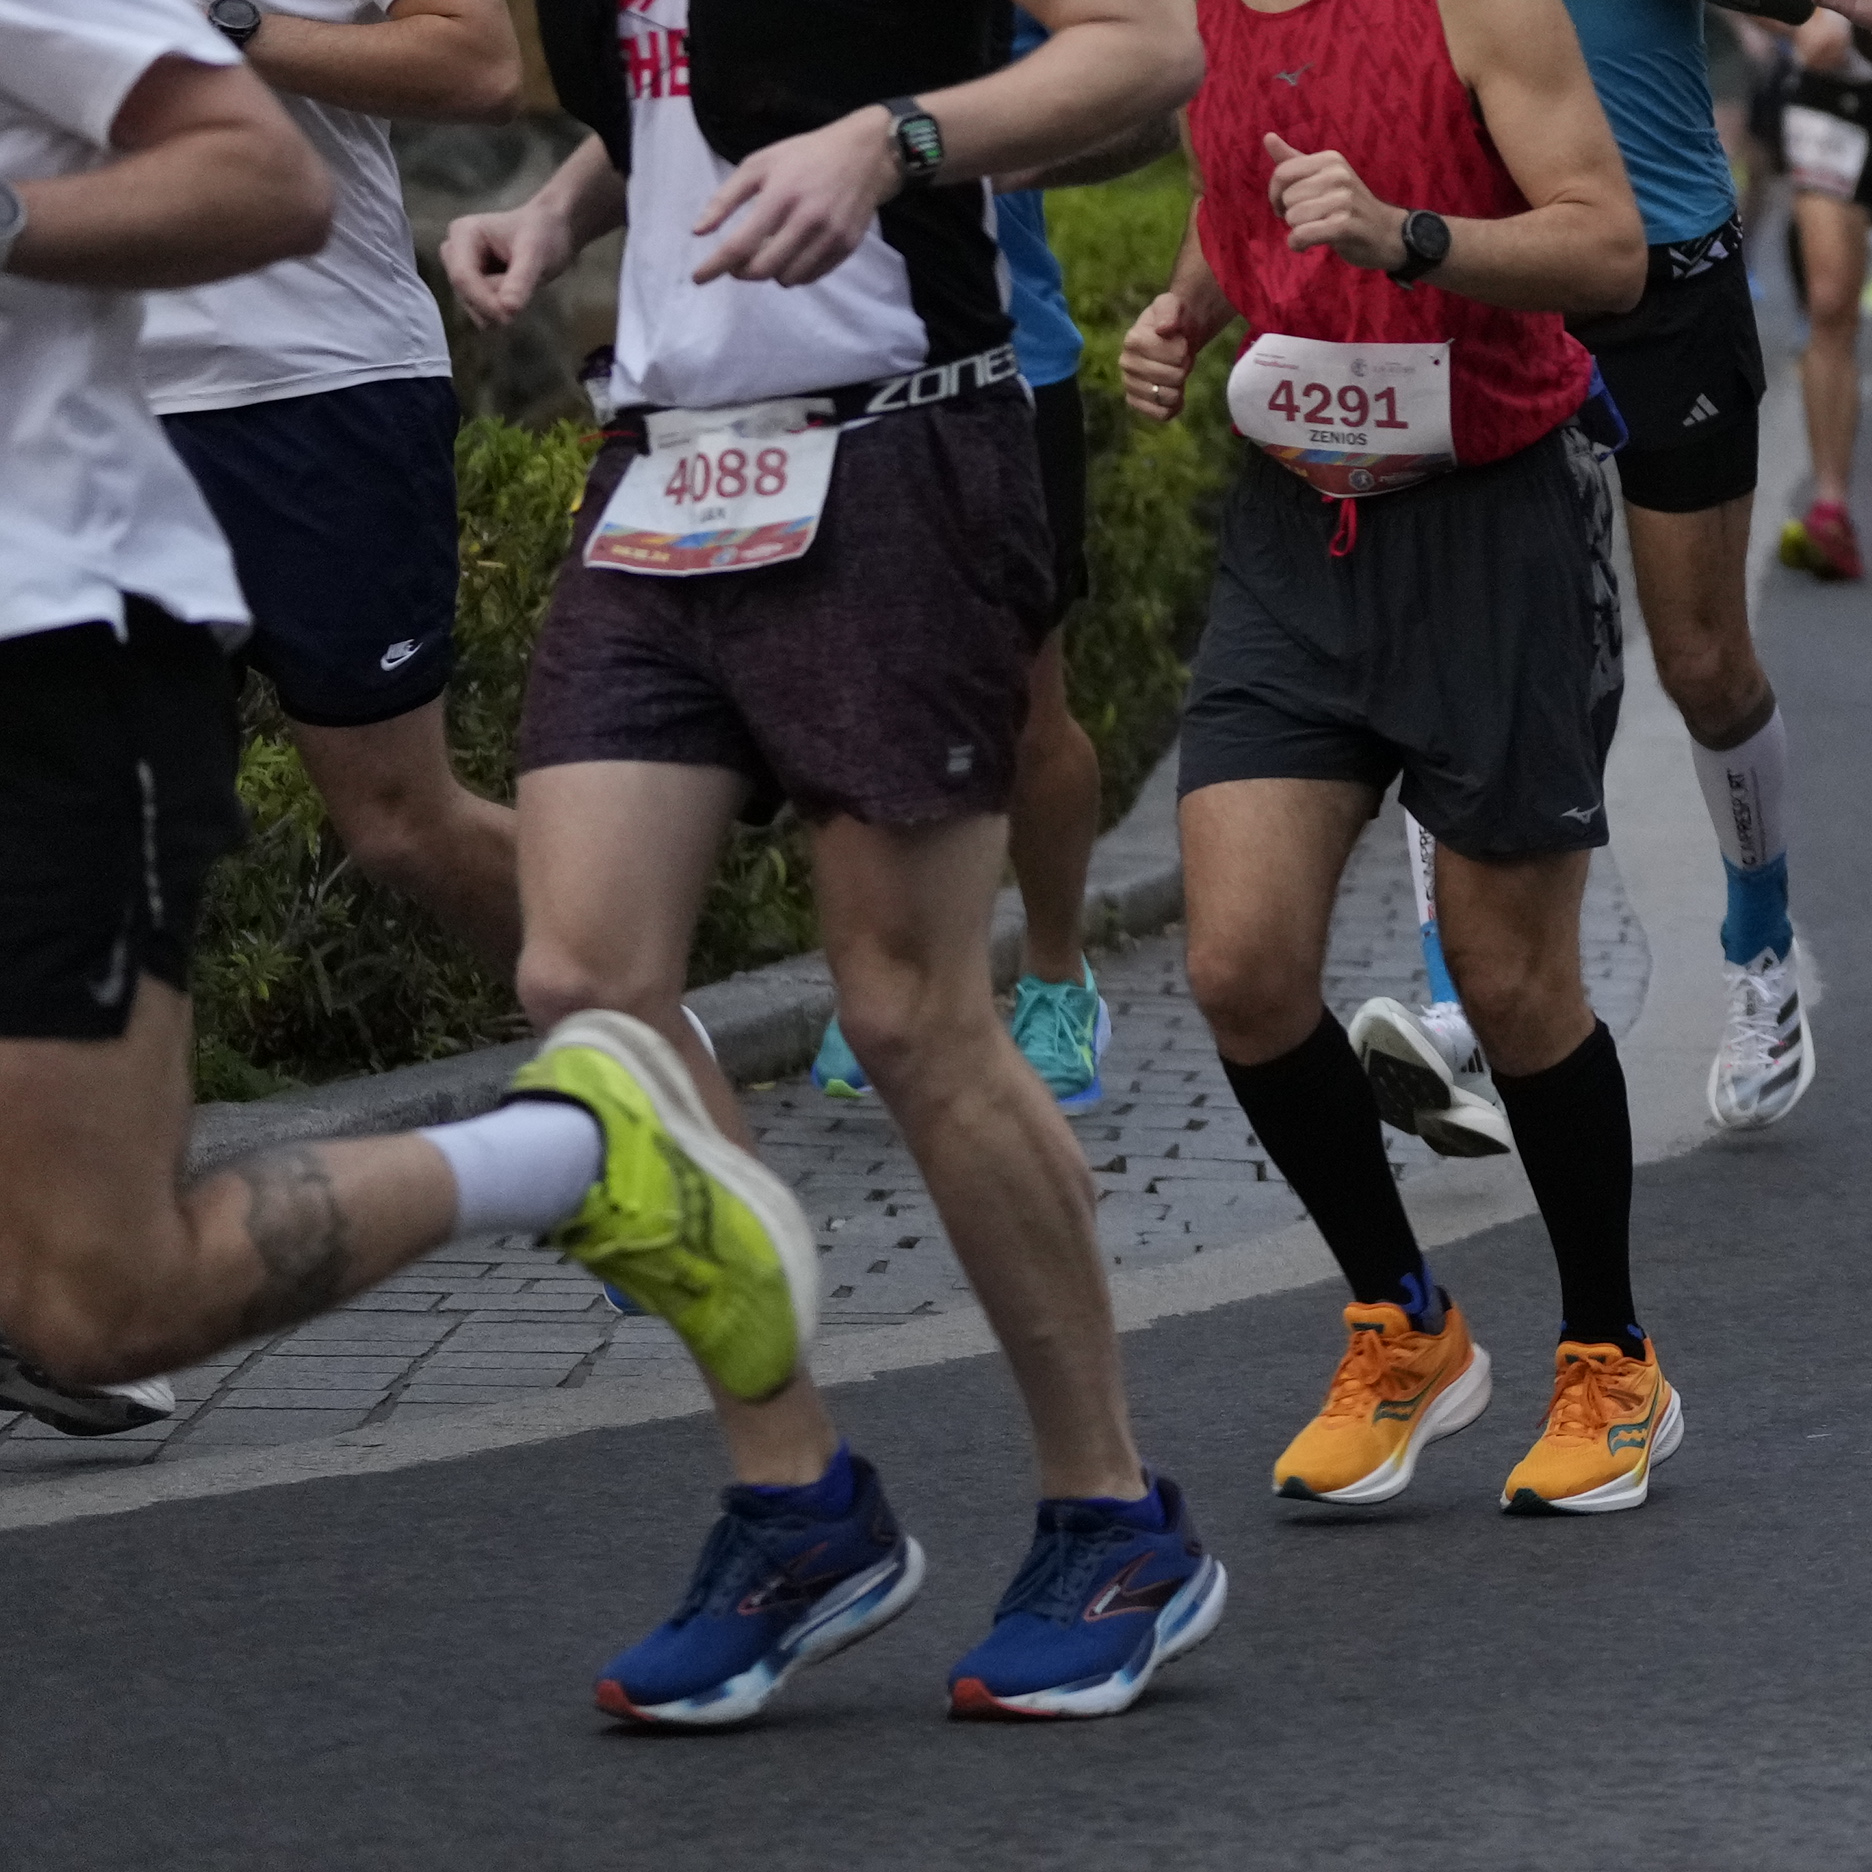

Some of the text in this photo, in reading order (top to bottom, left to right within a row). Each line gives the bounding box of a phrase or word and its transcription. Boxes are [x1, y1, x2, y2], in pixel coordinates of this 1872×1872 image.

[1268, 379, 1409, 429] 4291
[1309, 429, 1367, 446] ZENIOS
[664, 447, 788, 505] 4088
